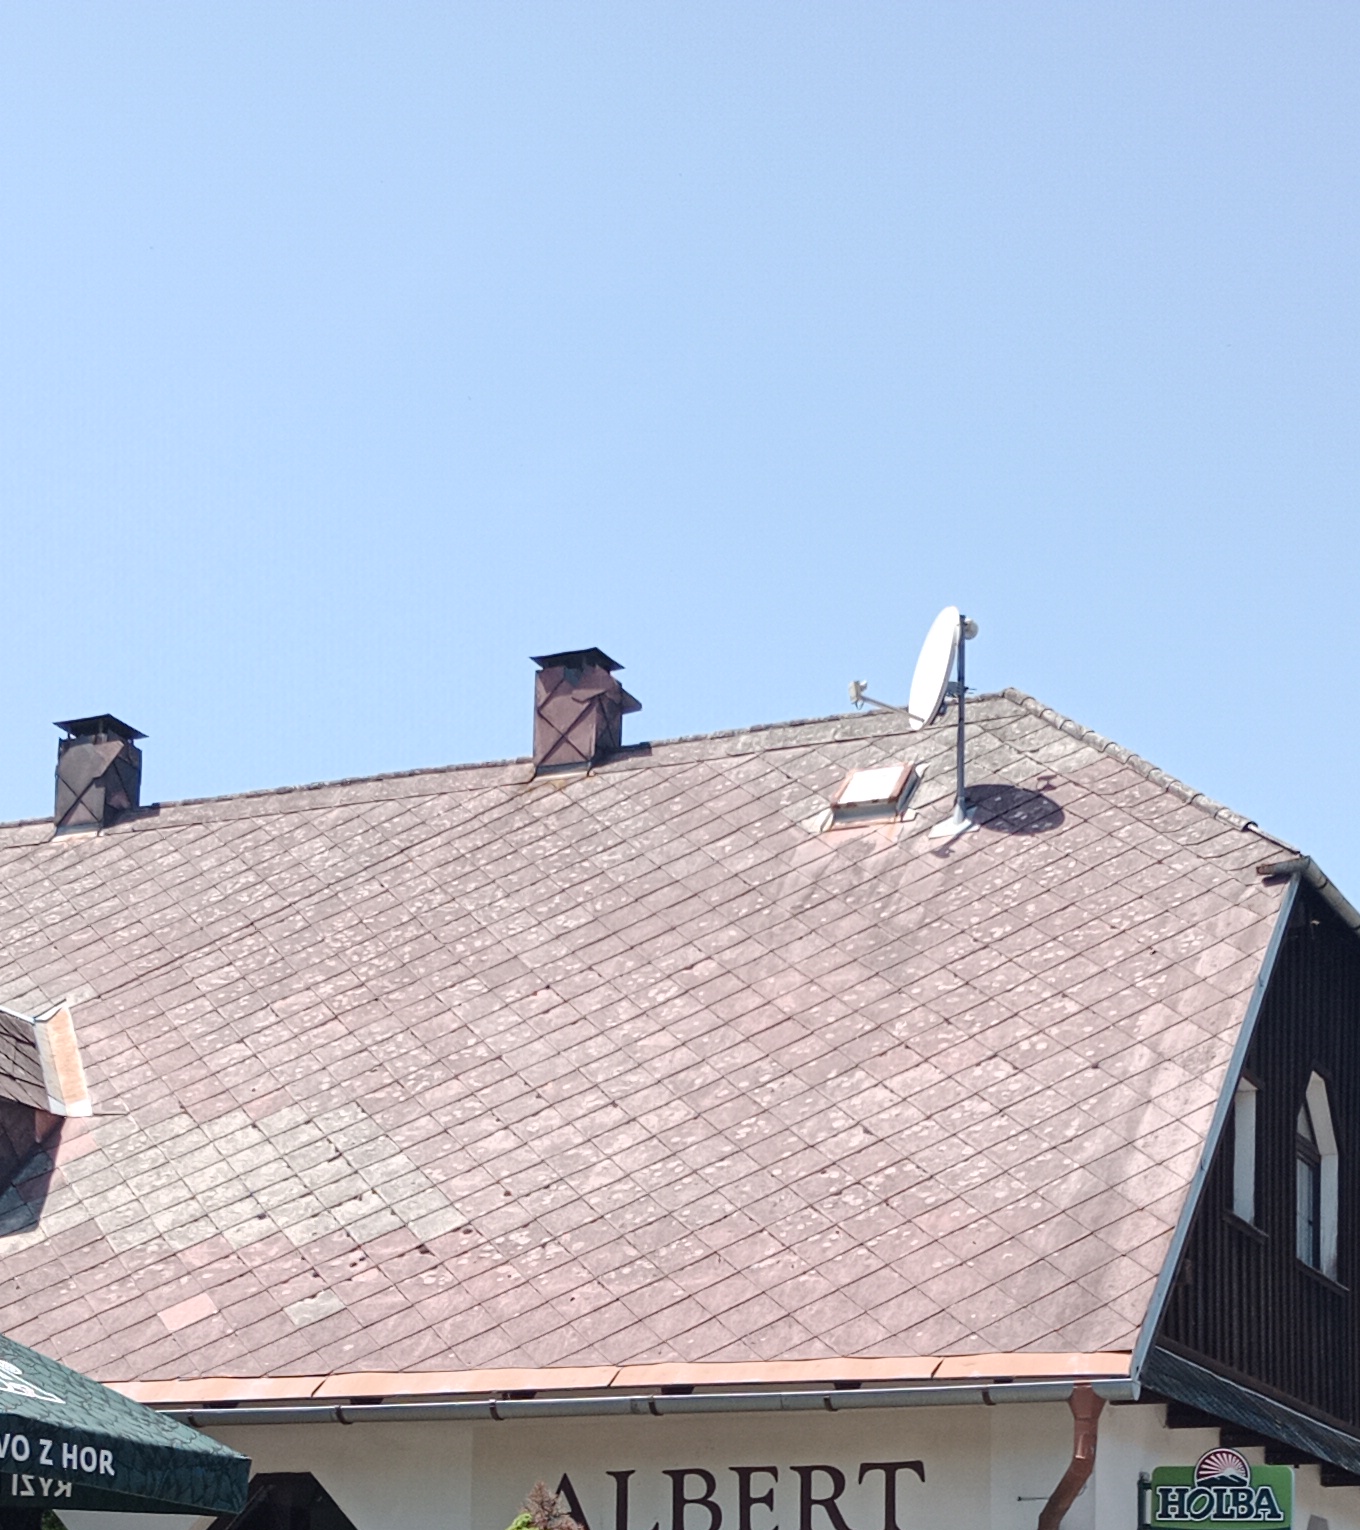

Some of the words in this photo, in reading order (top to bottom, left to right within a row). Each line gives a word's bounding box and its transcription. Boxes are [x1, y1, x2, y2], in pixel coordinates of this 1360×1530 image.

[38, 1439, 54, 1466] Z
[62, 1443, 115, 1477] HOR
[1155, 1485, 1284, 1522] HOLBA
